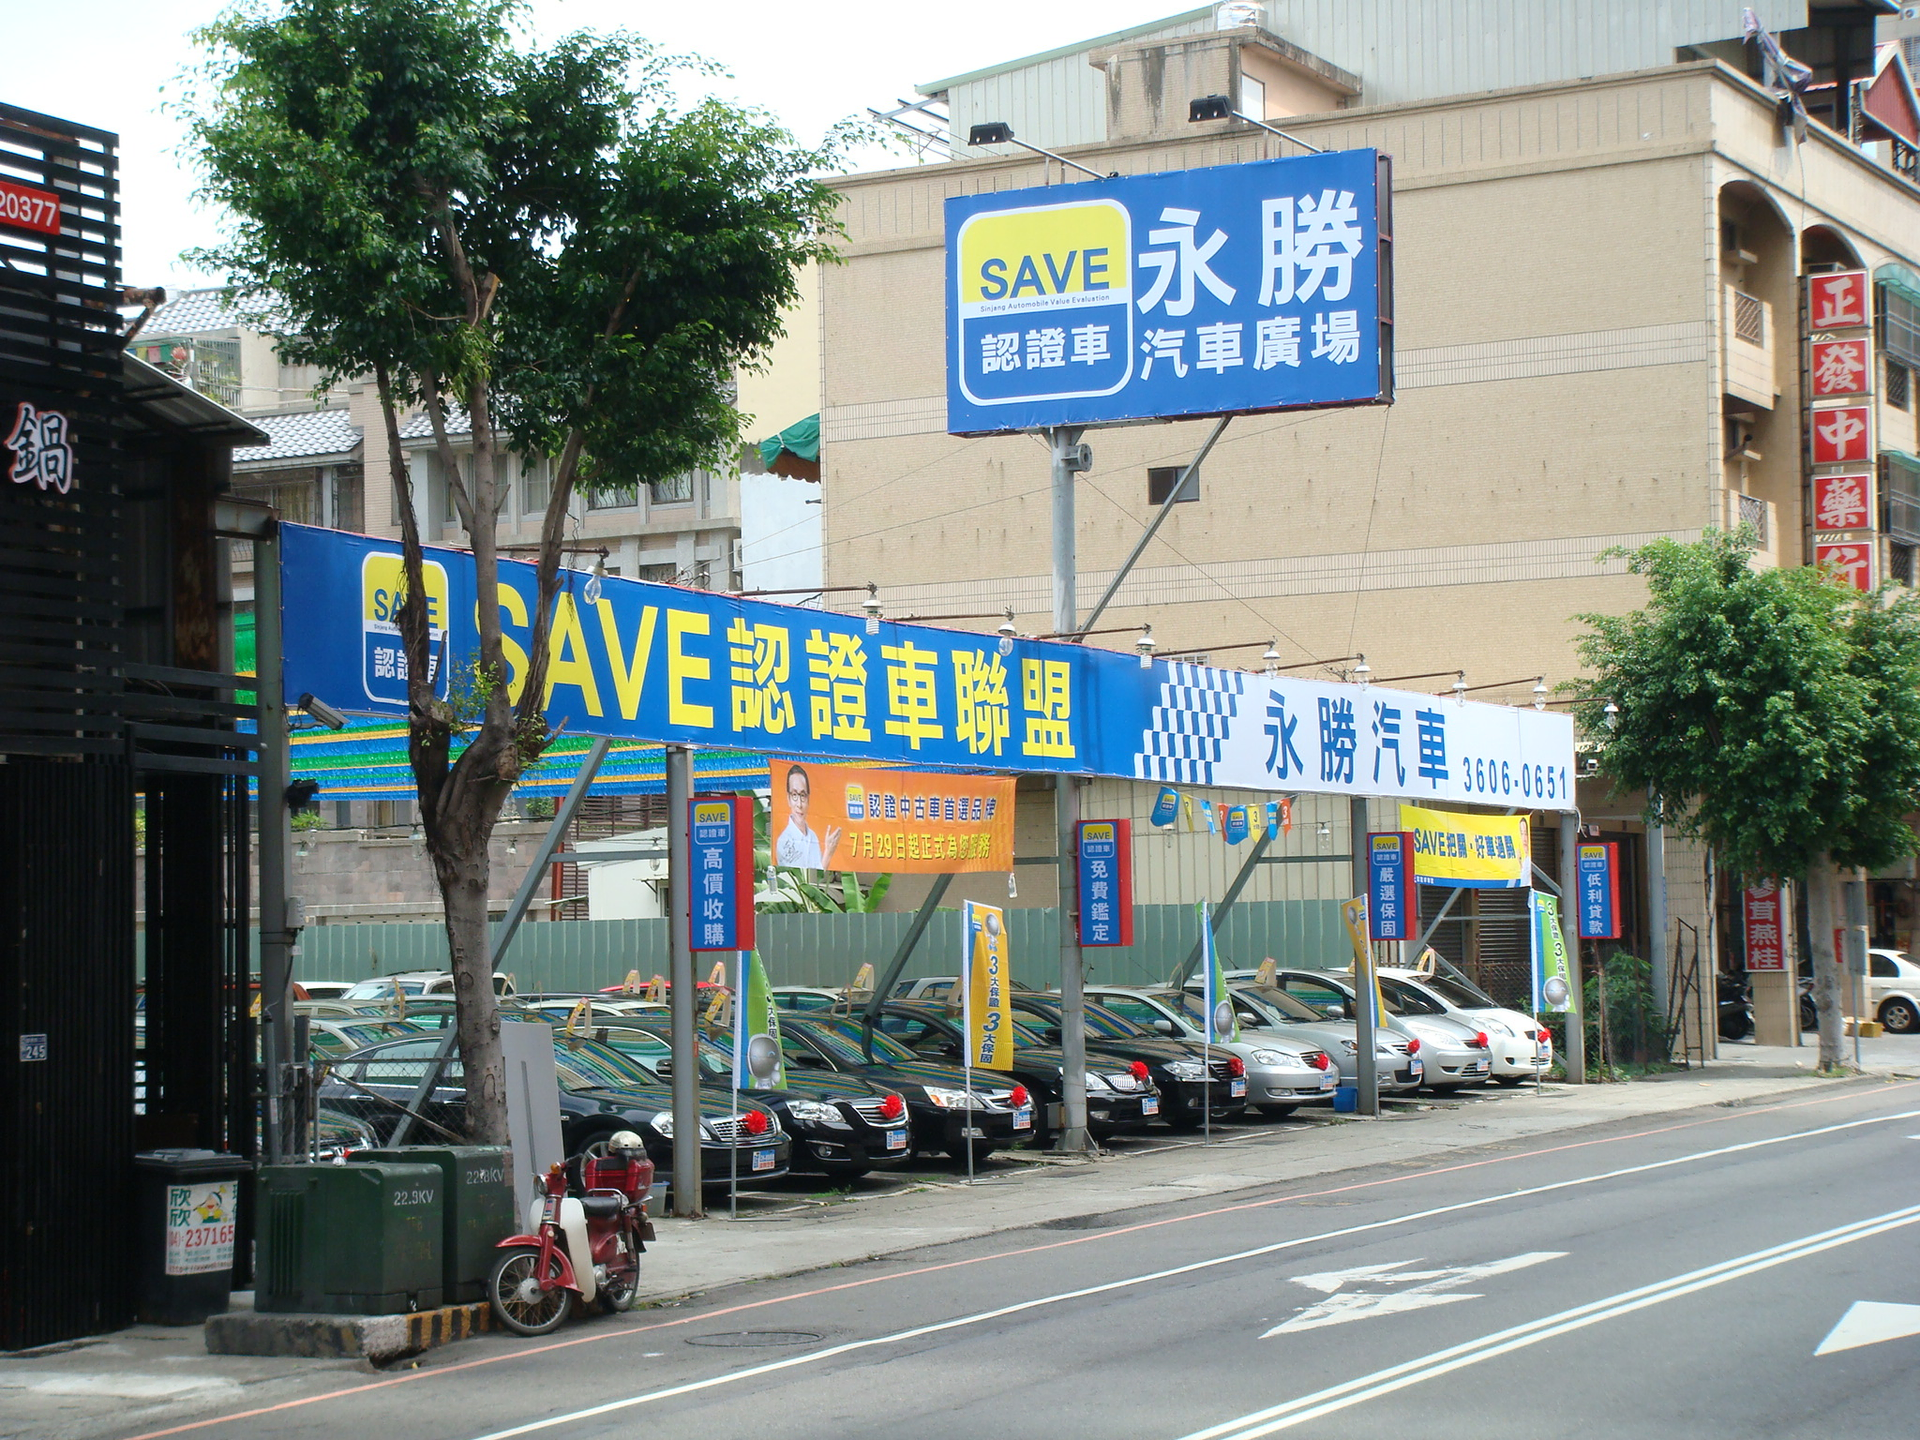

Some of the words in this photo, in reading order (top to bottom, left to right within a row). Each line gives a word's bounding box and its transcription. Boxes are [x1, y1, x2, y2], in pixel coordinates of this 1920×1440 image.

[980, 247, 1110, 301] SAVE
[1136, 188, 1364, 317] 永勝
[980, 304, 1006, 313] Sinjang
[1008, 300, 1049, 310] Automobile
[1050, 298, 1070, 306] Value
[1072, 294, 1110, 304] Evaluation
[980, 323, 1111, 375] 認證車
[1139, 309, 1362, 381] 汽車廣場
[3, 401, 74, 495] 鍋
[374, 588, 438, 630] SAE
[1263, 688, 1450, 791] 永勝汽車
[1462, 756, 1567, 800] 3606-0651
[699, 812, 726, 823] SAVE
[868, 793, 997, 822] 認證中古車首選品牌
[1086, 831, 1110, 840] SAVE
[1376, 842, 1397, 850] SAVE
[702, 847, 725, 946] 高價收購
[1090, 860, 1110, 941] 免費鑑定
[1379, 867, 1396, 937] 嚴選保固
[1586, 873, 1604, 934] 低利貸款
[169, 1188, 191, 1227] 欣欣
